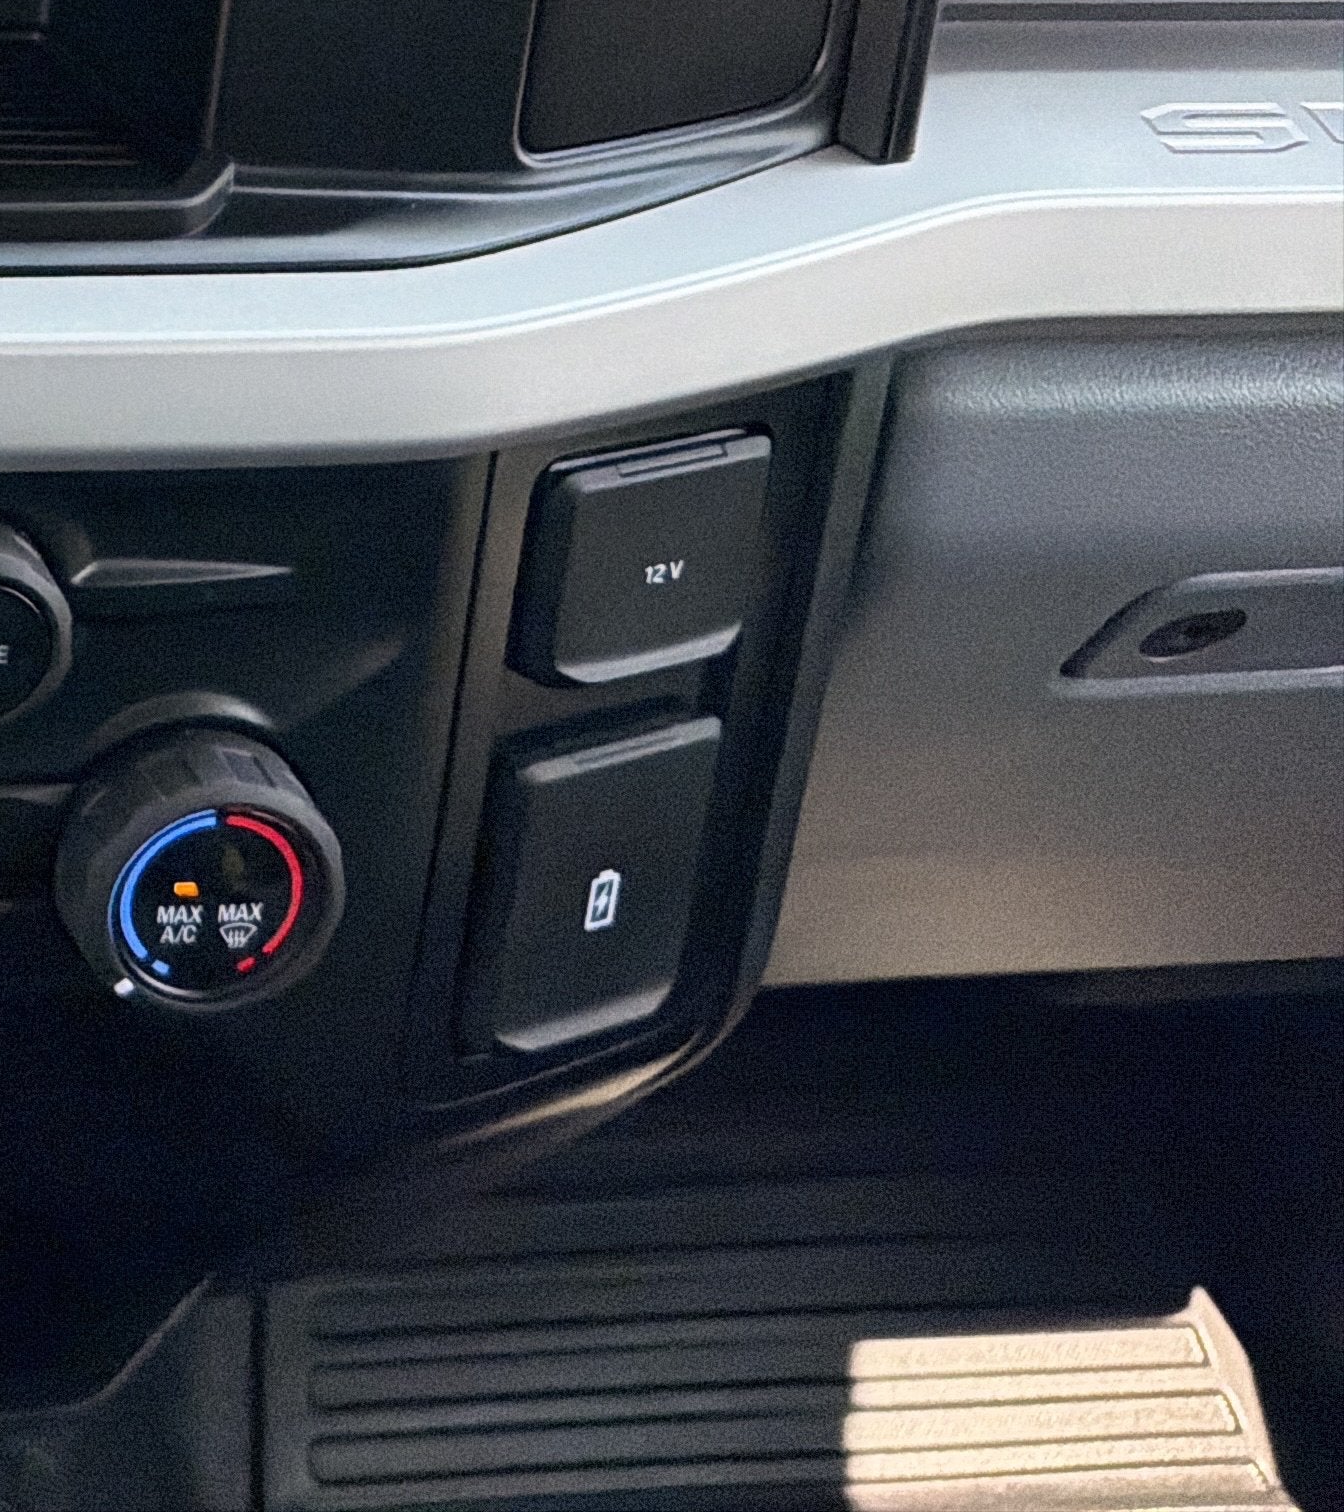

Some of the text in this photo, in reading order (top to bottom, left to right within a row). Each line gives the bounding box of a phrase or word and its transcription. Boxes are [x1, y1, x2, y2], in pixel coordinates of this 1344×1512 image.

[156, 904, 202, 925] MAX
[217, 901, 263, 922] MAX
[160, 924, 198, 945] A/C
